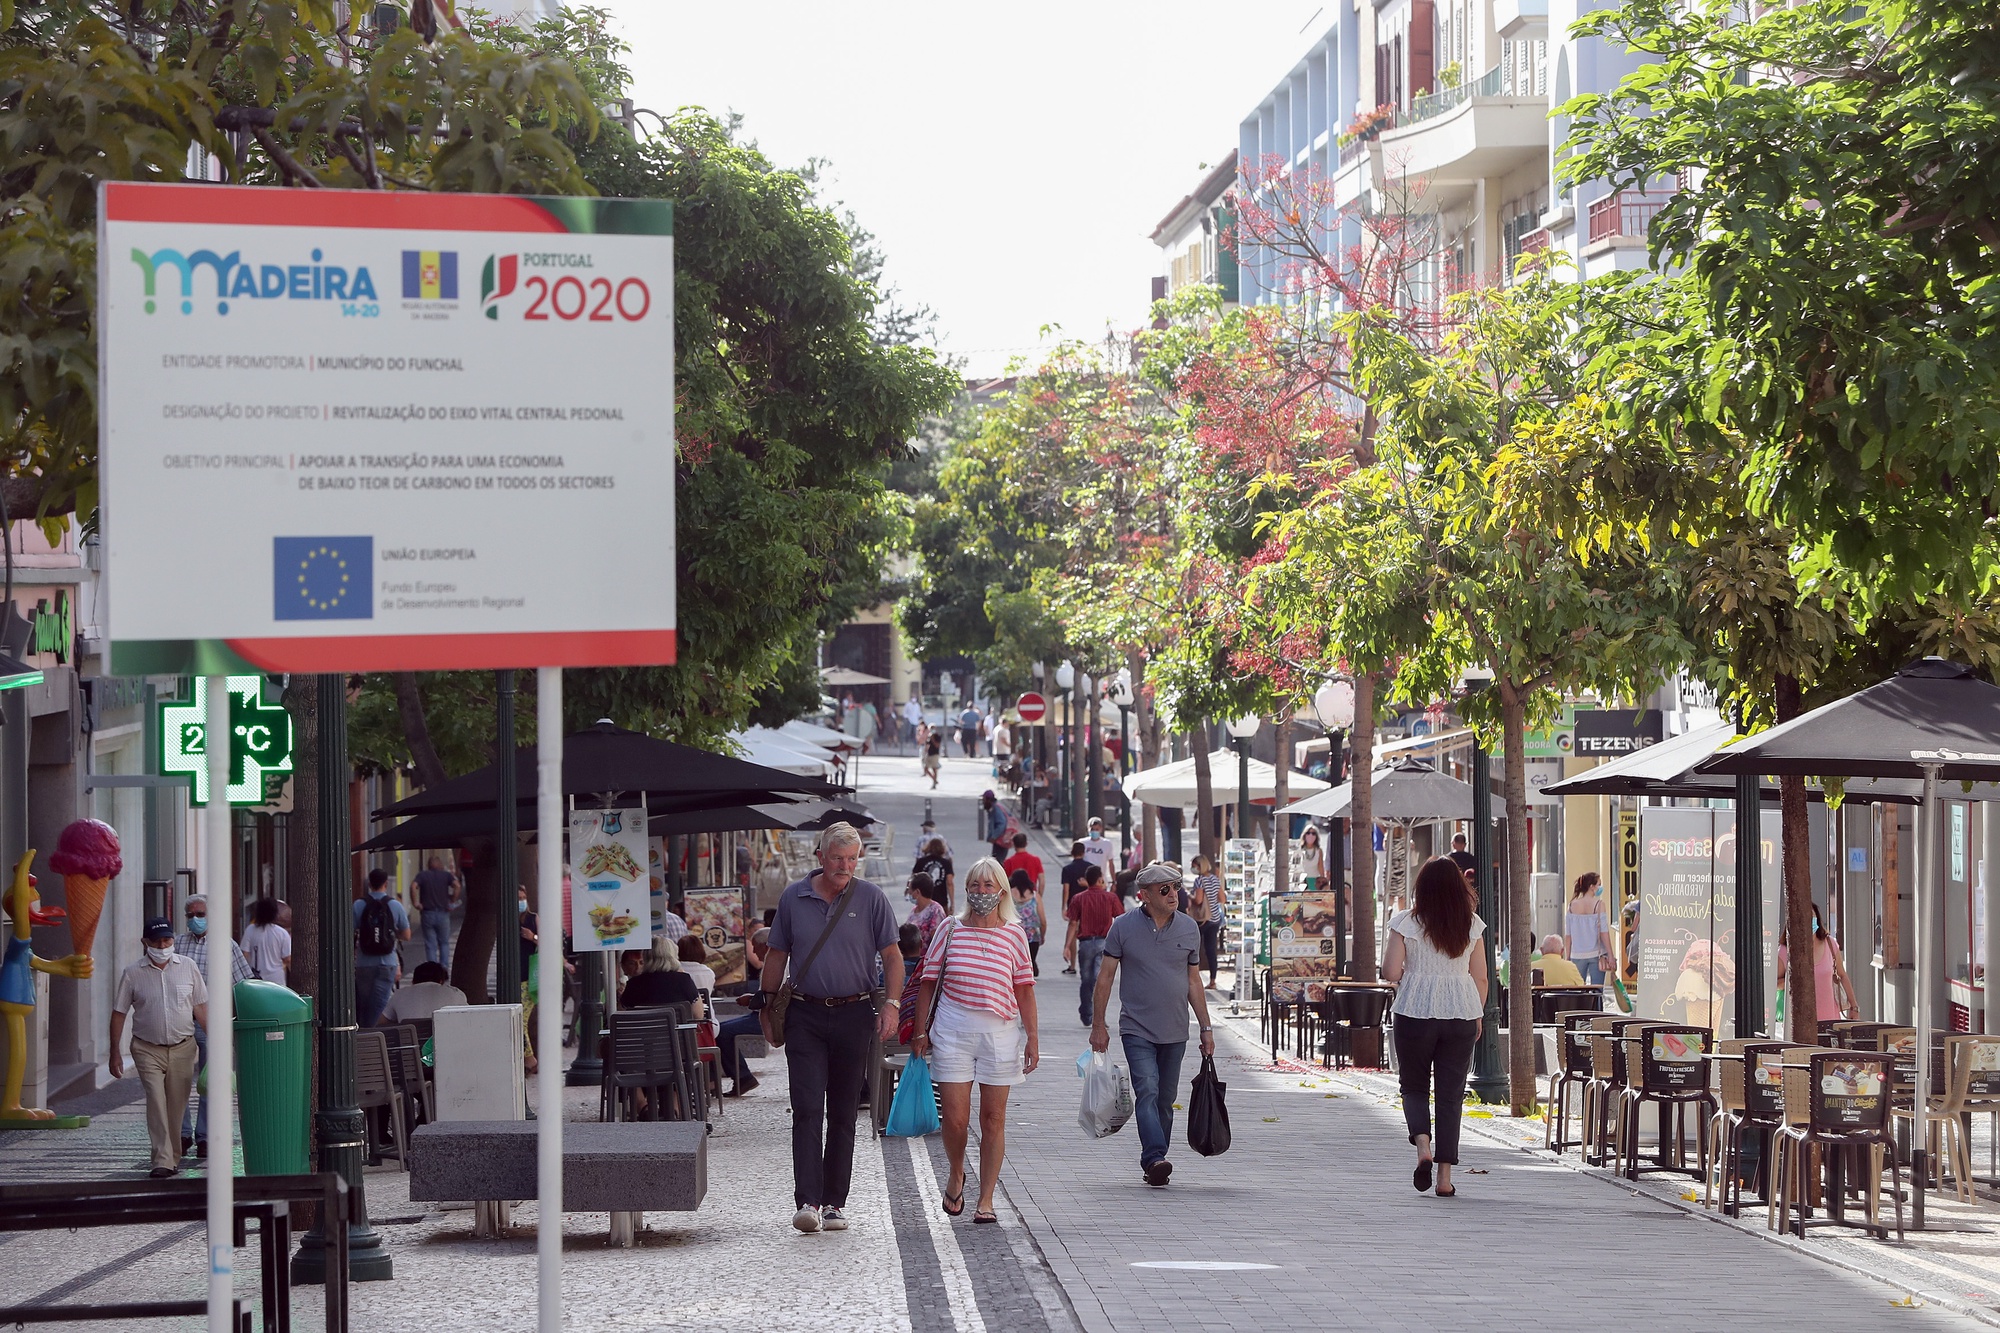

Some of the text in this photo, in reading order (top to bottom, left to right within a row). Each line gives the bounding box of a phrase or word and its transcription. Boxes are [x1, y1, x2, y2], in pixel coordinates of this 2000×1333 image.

[523, 252, 594, 267] PORTUGAL
[523, 275, 651, 322] 2020
[341, 304, 379, 317] 14-20
[162, 354, 464, 371] ENTIDADE PROMOTORA MUNICÍPIO DO FUNCHAL
[162, 402, 624, 421] DESIGNAÇÃO DO PROJETO REVITALIZAÇÃO DO EIXO VITAL CENTRAL PEDONAL
[162, 453, 564, 471] OBJETIVO PRINCIPAL APOIAR A TRANSIÇÃO PARA UMA ECONOMIA
[298, 476, 615, 490] DE BAIXO TEOR DE CARBONO EM TODOS OS SECTORES
[381, 547, 477, 561] UNIÃO EUROPEIA
[381, 581, 457, 595] Fundo Europeu
[381, 596, 525, 611] de Desenvolvimento Regional
[235, 726, 271, 751] °C
[1579, 735, 1656, 751] TEZENIS
[1851, 852, 1863, 863] AL
